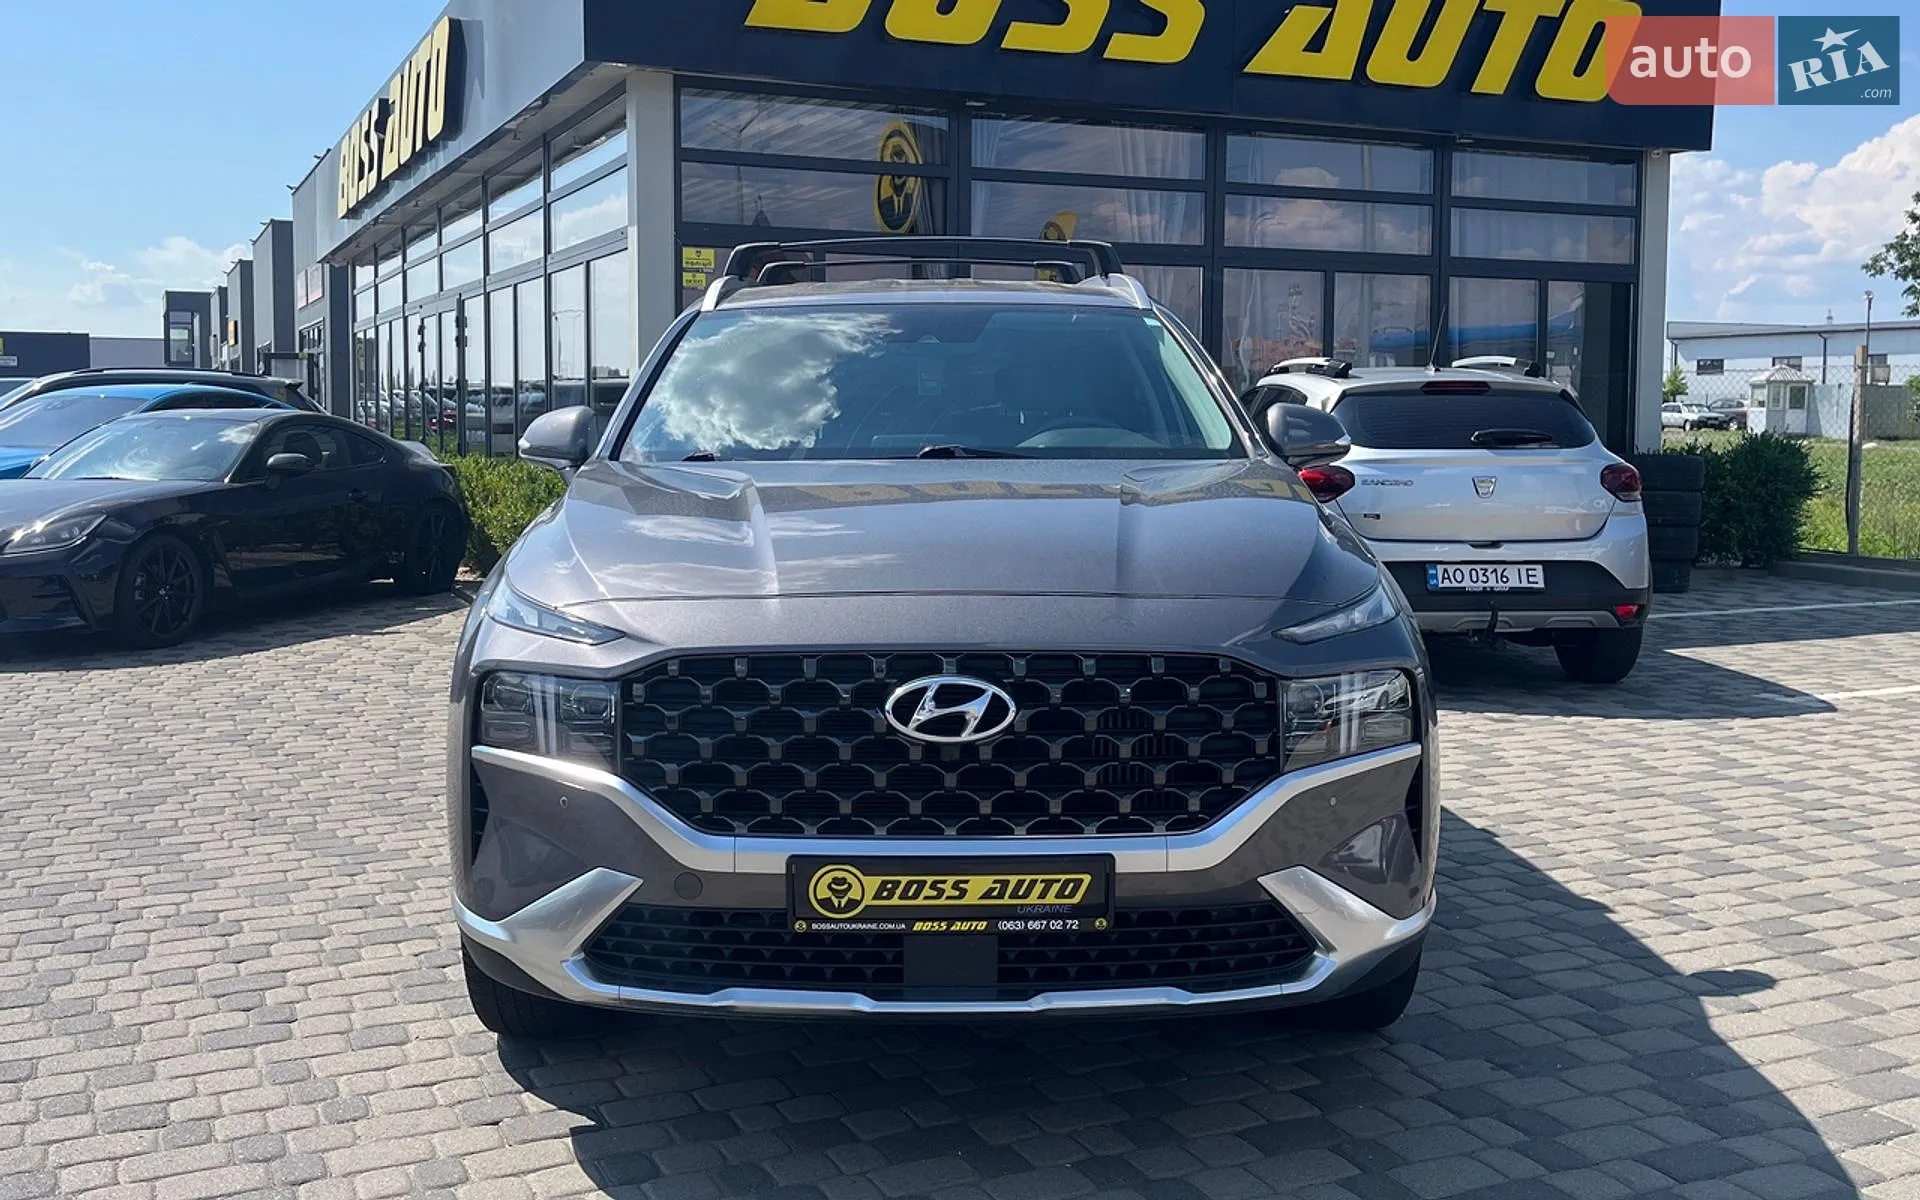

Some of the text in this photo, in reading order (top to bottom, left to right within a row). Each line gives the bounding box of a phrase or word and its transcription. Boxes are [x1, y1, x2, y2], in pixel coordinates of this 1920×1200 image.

[1243, 0, 1643, 102] AUTO
[338, 15, 450, 219] BOSS AUTO
[1441, 568, 1465, 585] AO
[1469, 568, 1510, 585] 0316
[1517, 568, 1539, 585] IE
[872, 878, 1085, 900] BOSS AUTO
[1017, 904, 1073, 914] UKRAINE
[811, 919, 1079, 932] BOSSAUTOUKRAINE.COM.UA BOSS AUTO (063) 667 02 72
